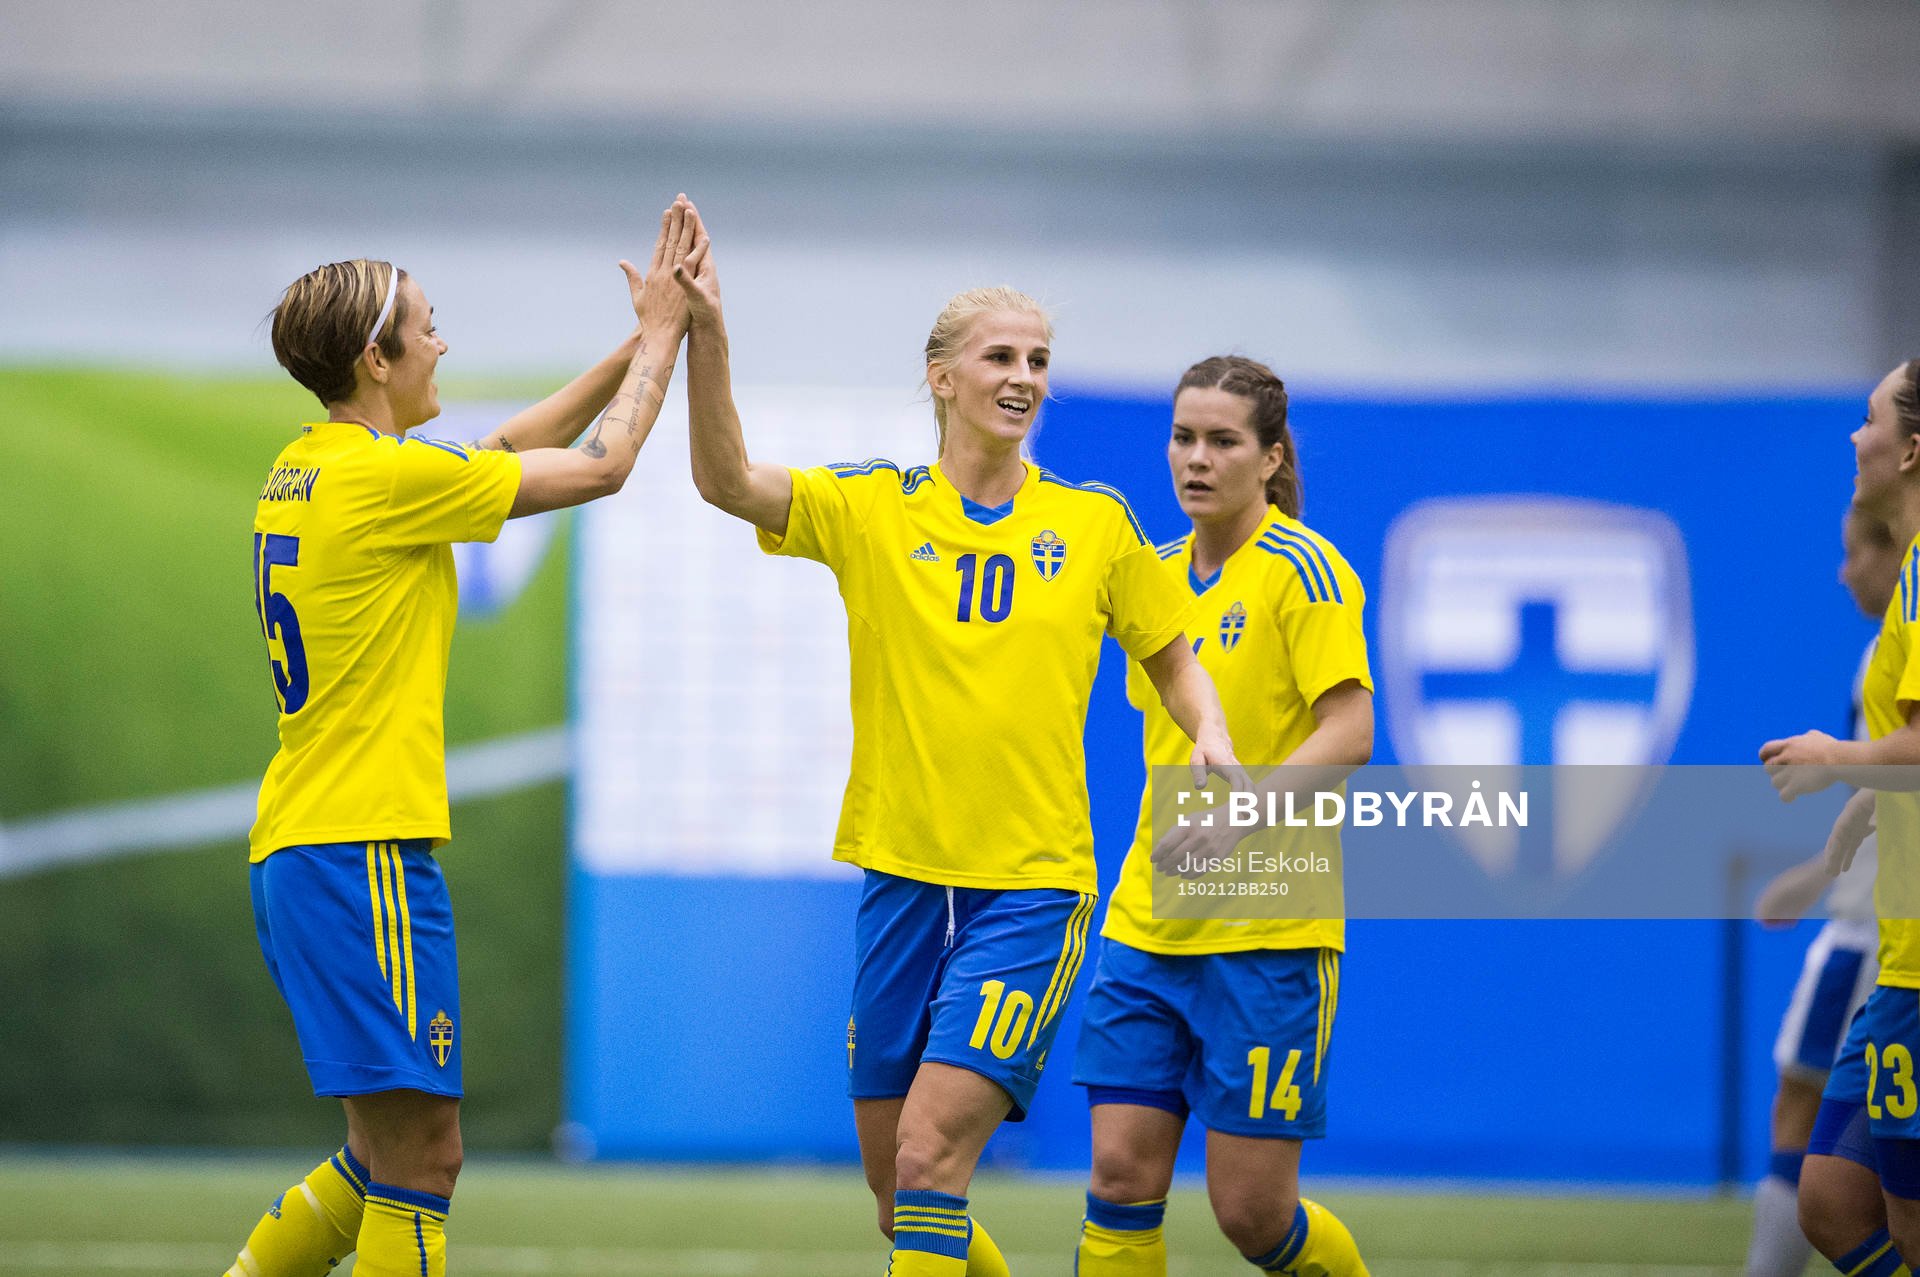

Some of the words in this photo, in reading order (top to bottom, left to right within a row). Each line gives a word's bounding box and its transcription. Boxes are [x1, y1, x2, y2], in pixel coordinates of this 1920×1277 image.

[910, 552, 940, 562] adidas
[956, 553, 1015, 623] 10
[969, 980, 1034, 1060] 10
[1247, 1046, 1302, 1121] 14
[1864, 1041, 1918, 1120] 23
